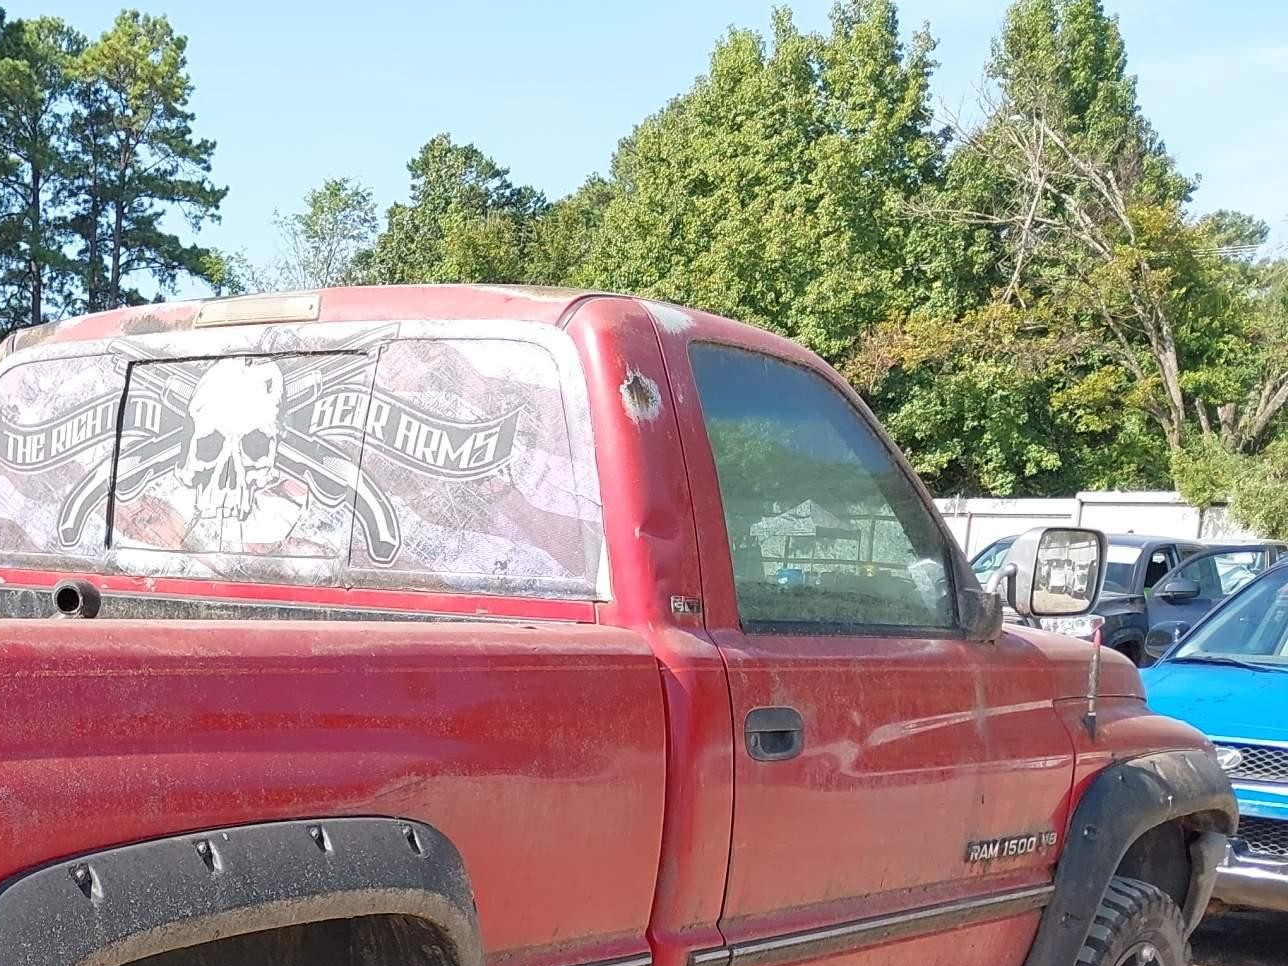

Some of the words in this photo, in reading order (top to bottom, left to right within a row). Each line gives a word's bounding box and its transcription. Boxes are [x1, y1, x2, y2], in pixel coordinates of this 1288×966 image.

[3, 430, 46, 464] THE
[50, 402, 117, 457] RIGHT
[309, 392, 392, 440] BEAR
[393, 411, 503, 469] ARMS
[969, 843, 999, 862] RAM
[1002, 836, 1037, 856] 1500
